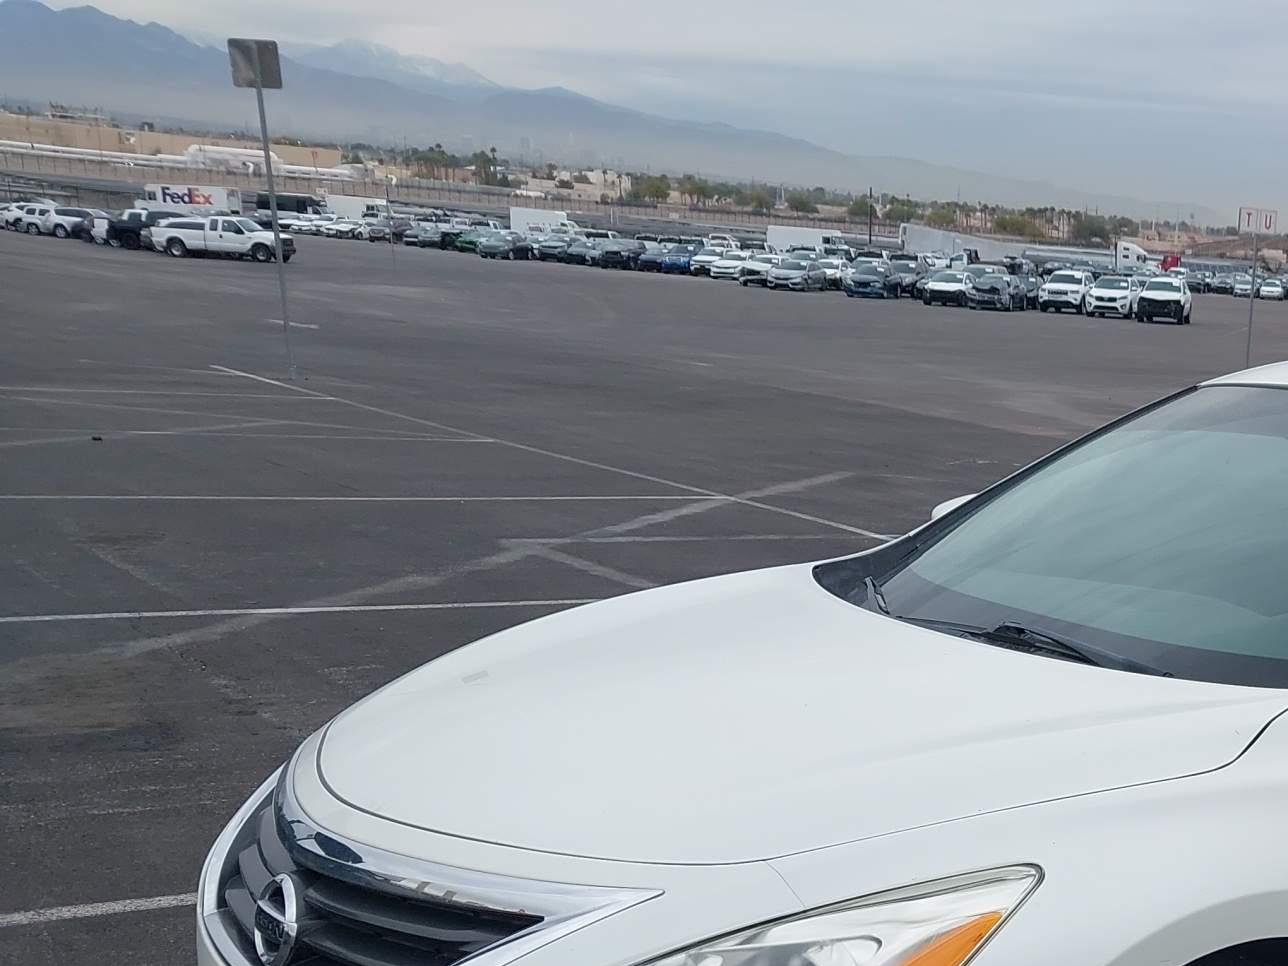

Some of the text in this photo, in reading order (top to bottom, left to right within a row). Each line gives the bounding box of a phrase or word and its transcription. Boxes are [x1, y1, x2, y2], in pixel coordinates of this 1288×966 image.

[161, 186, 214, 205] FedEx
[1246, 212, 1252, 227] T
[1265, 213, 1272, 230] U
